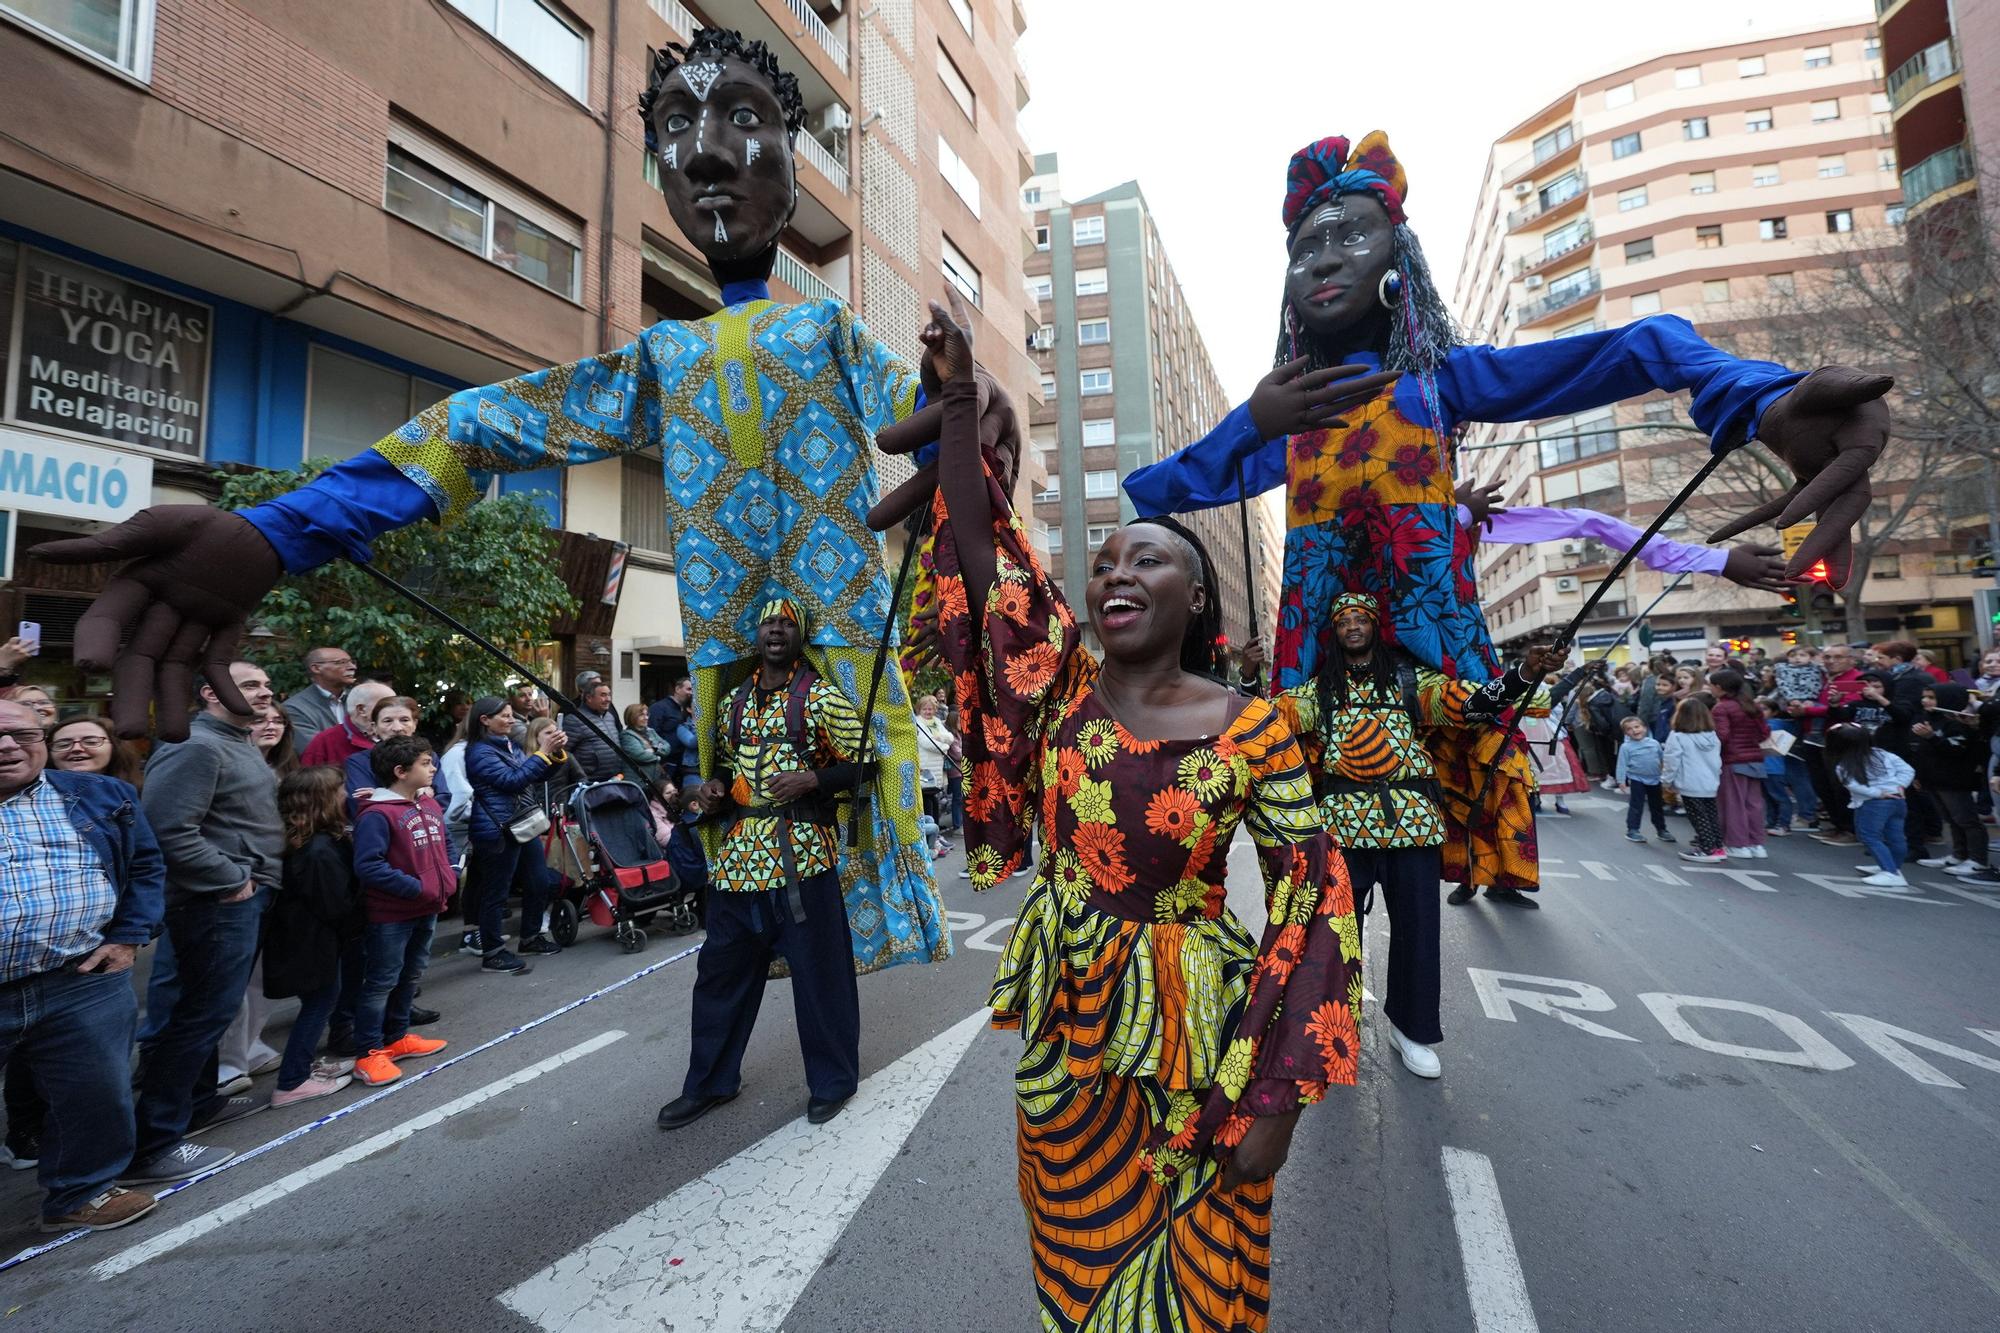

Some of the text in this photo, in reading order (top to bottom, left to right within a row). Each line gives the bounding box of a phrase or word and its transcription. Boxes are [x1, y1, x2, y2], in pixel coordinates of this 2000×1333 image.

[36, 268, 205, 344] TERAPIAS
[60, 309, 180, 373] YOGA
[29, 386, 193, 445] Relajación
[30, 355, 199, 417] Meditación
[0, 449, 128, 509] MACIÓ
